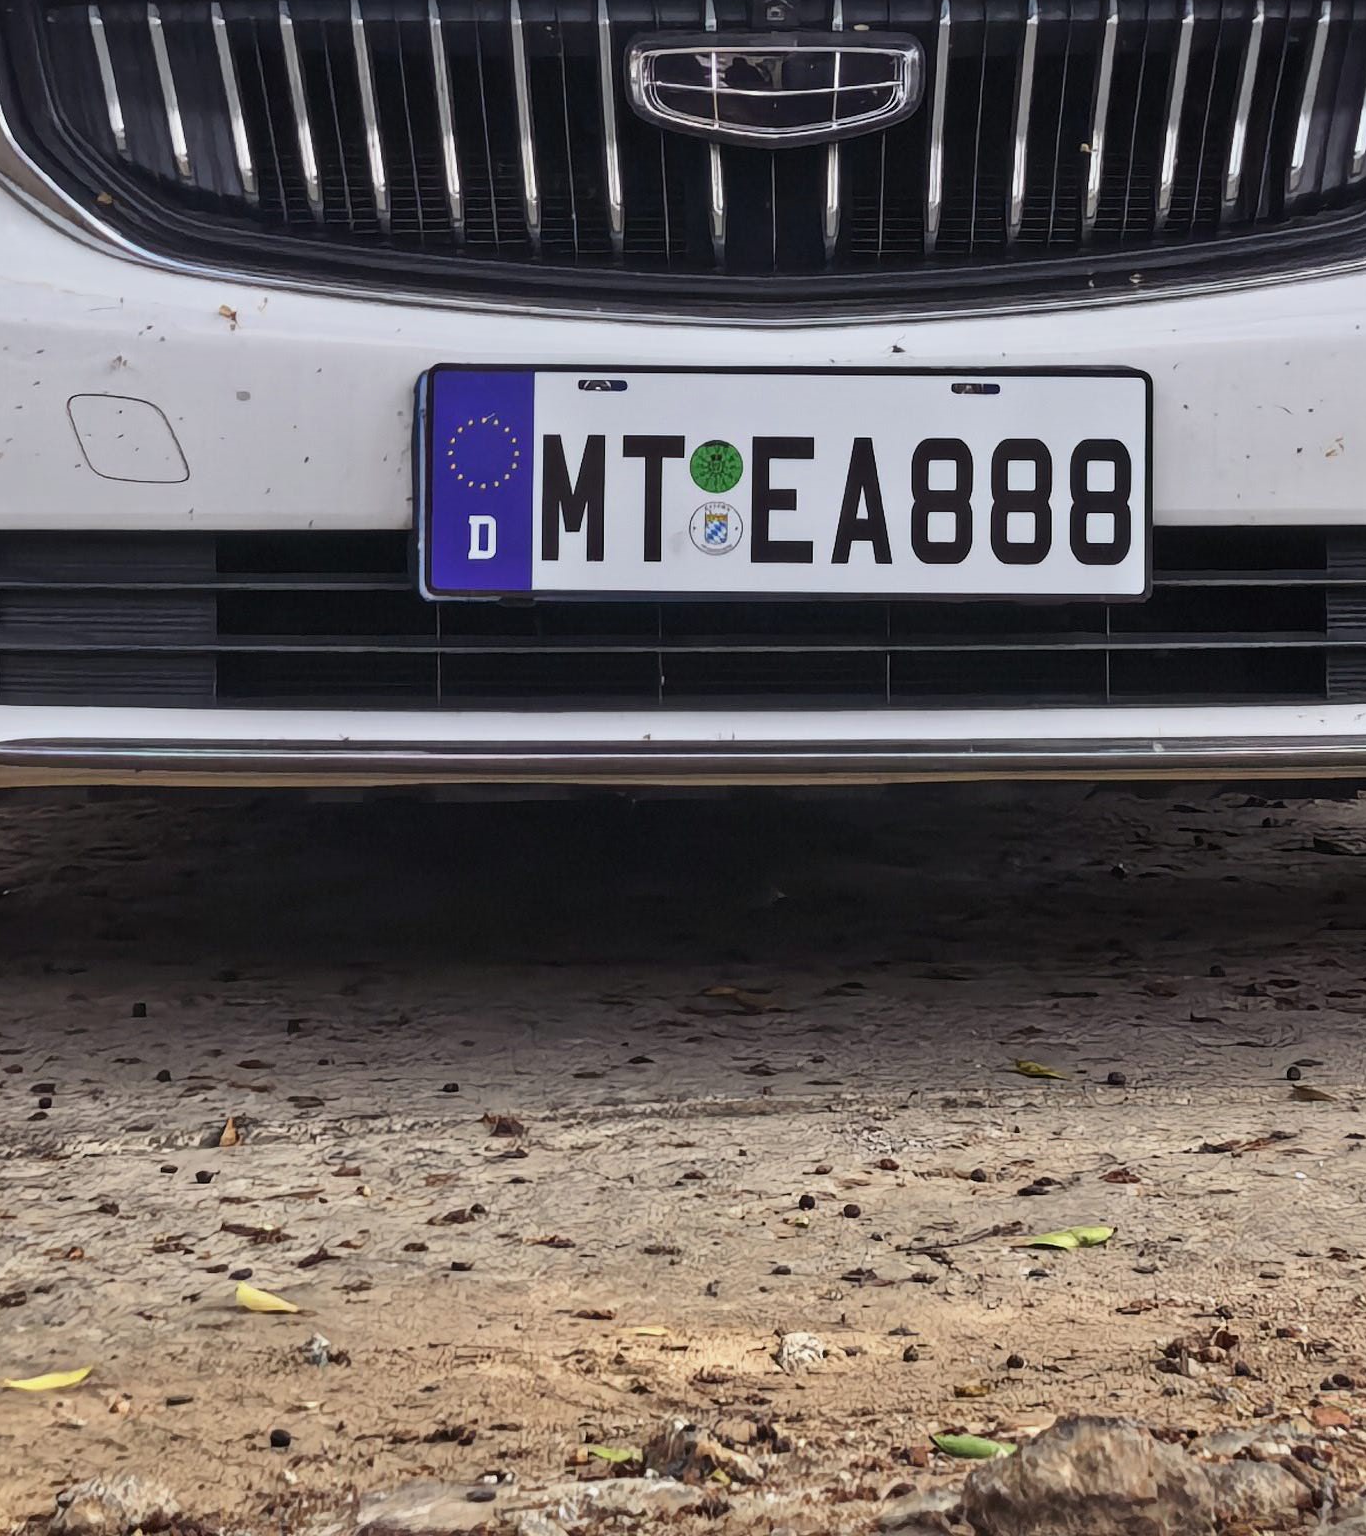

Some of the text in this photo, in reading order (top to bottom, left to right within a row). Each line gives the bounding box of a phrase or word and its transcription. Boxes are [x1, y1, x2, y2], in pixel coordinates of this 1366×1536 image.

[467, 515, 497, 560] D
[541, 434, 1132, 566] MT EA888
